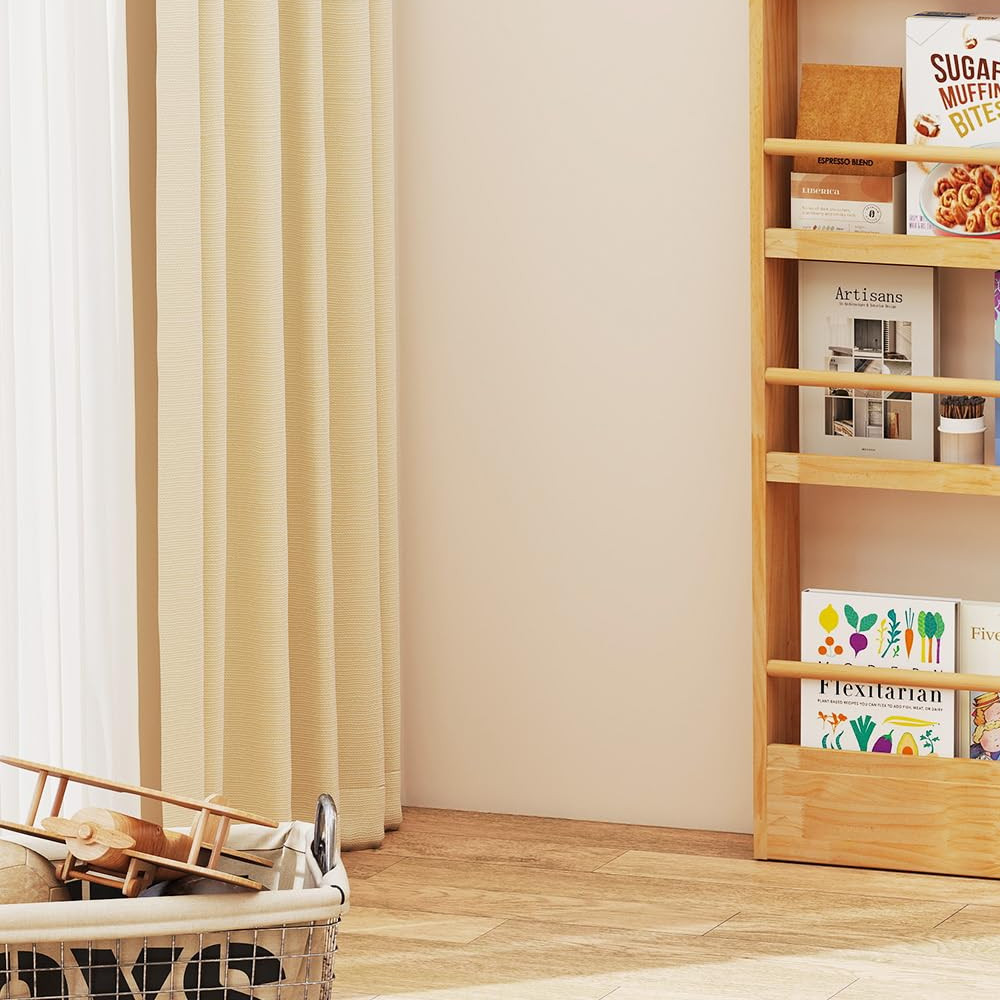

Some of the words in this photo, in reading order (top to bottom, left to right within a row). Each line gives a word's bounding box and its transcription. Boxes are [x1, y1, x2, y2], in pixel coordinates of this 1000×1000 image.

[817, 157, 851, 166] ESPRESSO
[851, 158, 874, 167] BLEND
[835, 286, 903, 304] Artisans
[819, 680, 942, 703] Flexitarian
